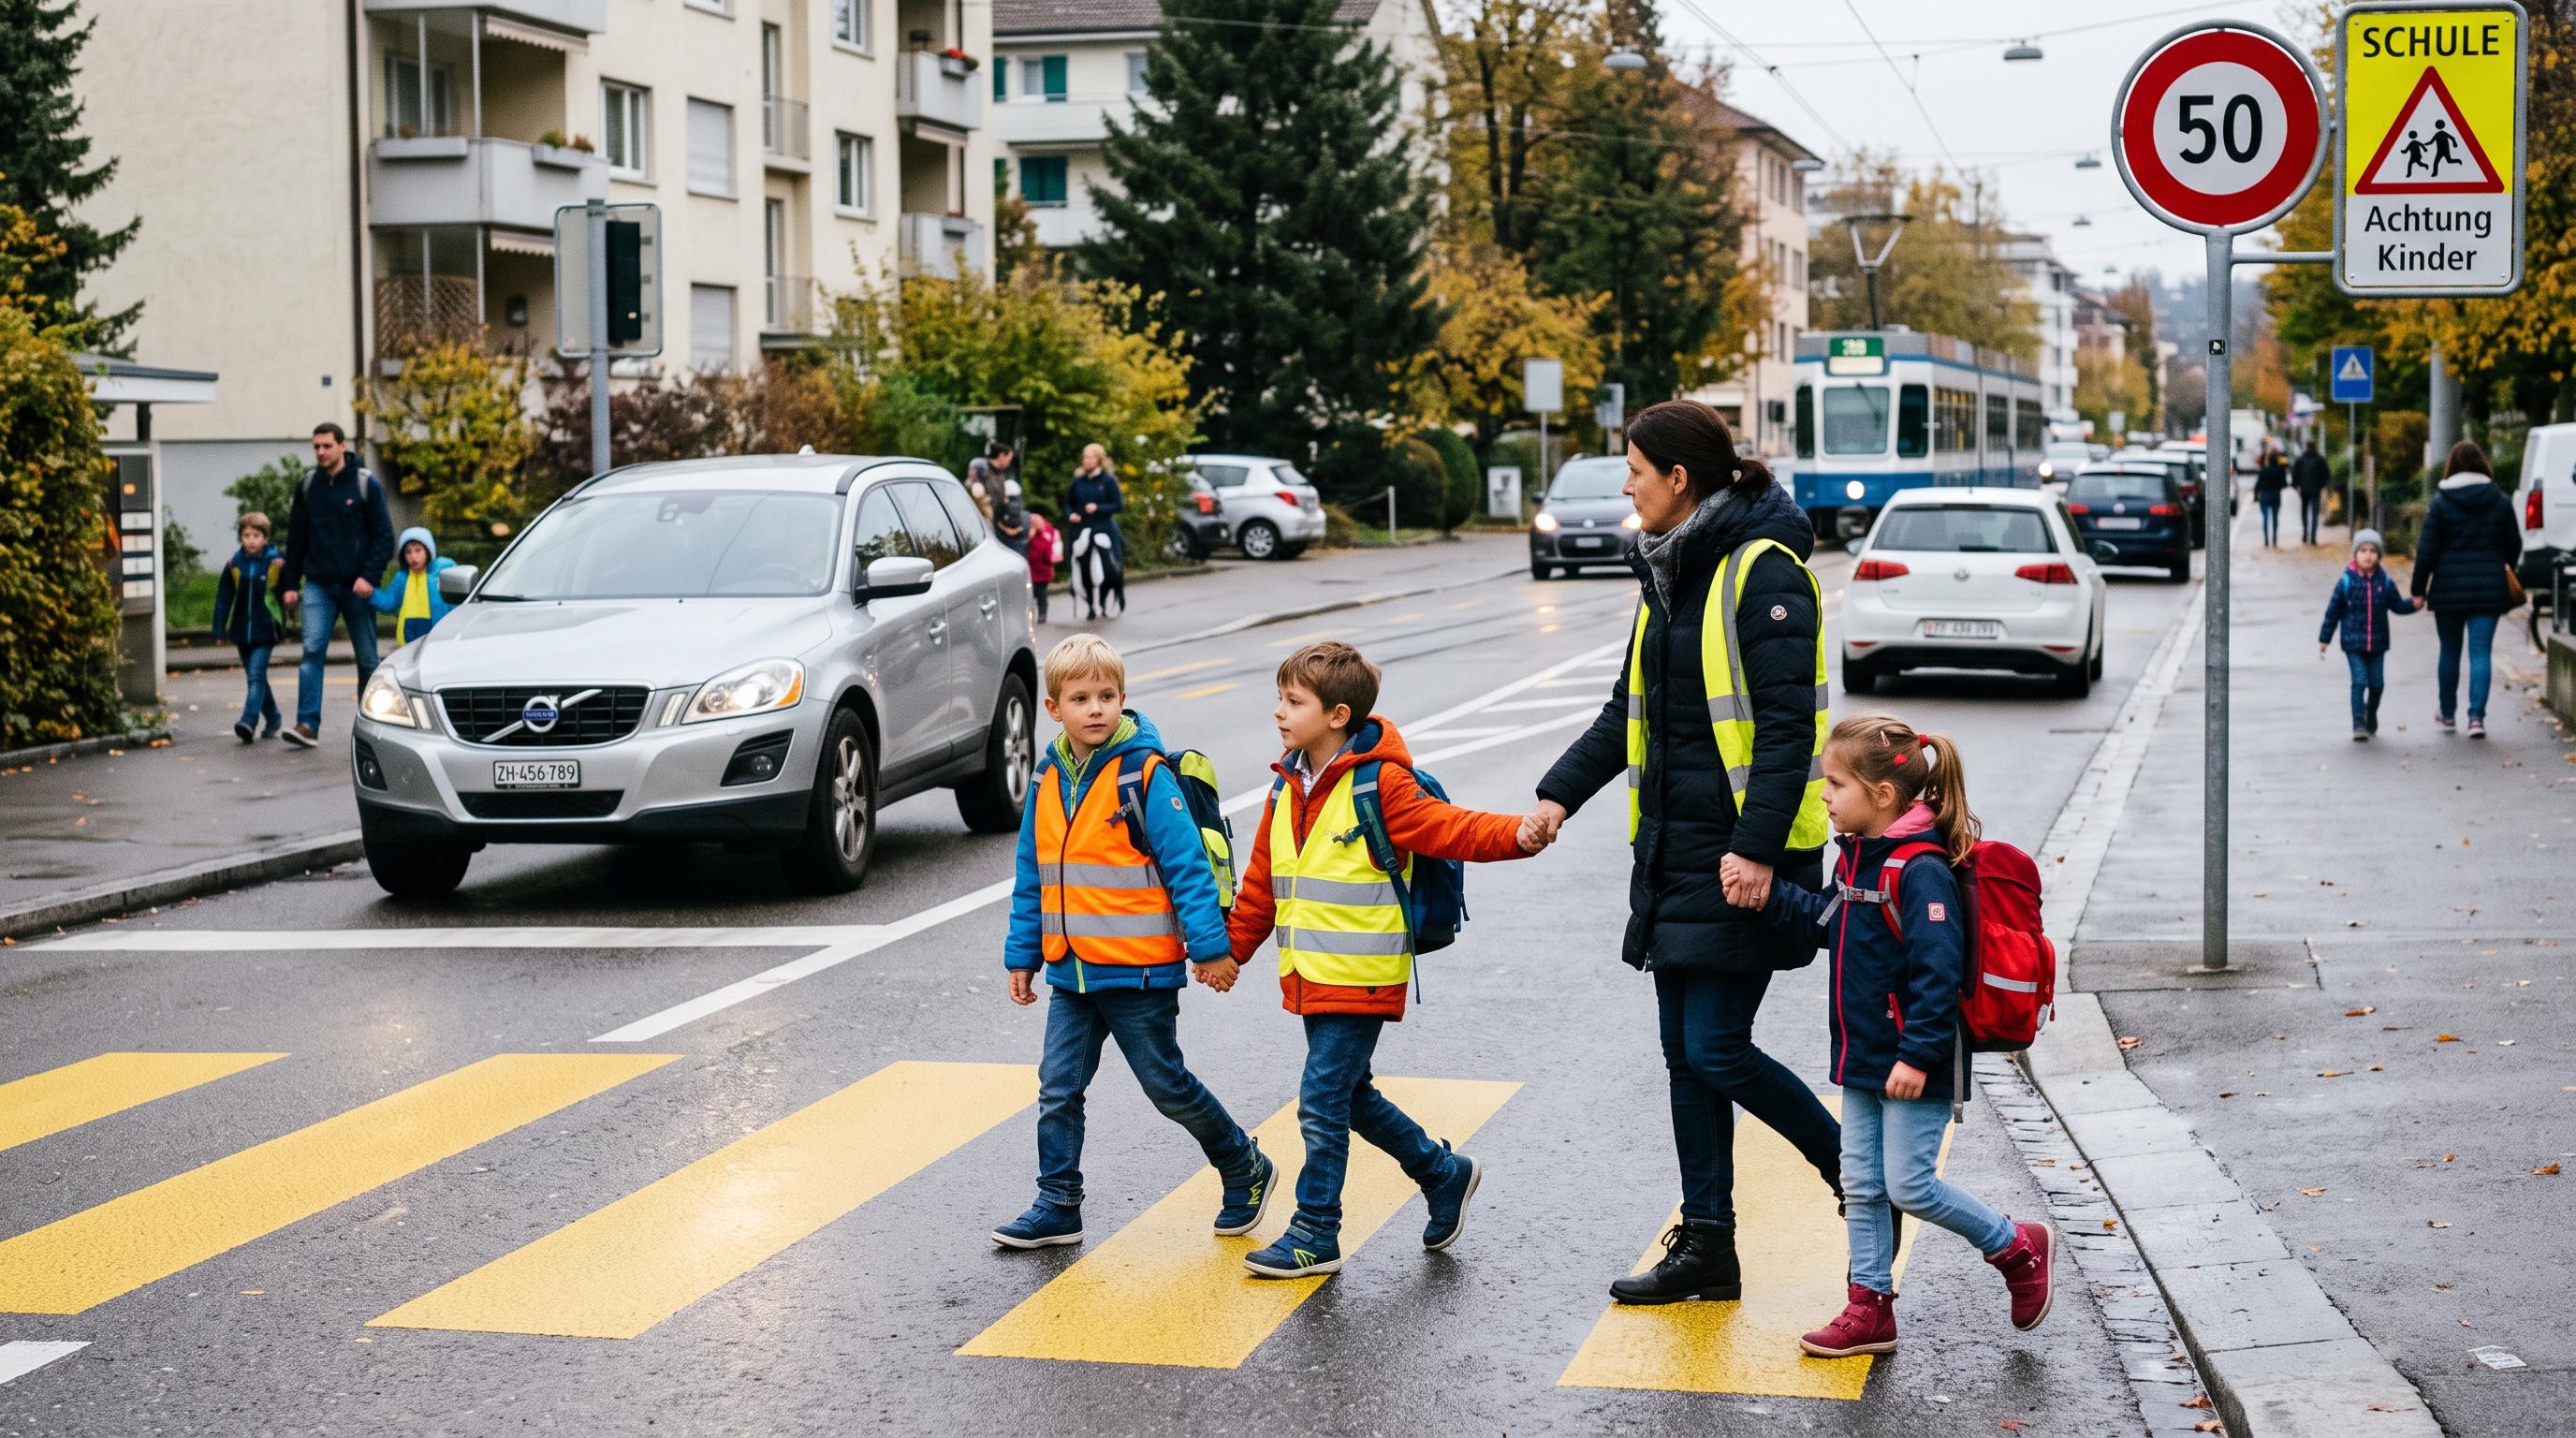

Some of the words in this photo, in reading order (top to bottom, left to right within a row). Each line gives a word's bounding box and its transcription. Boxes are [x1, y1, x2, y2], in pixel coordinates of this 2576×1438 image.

[2363, 24, 2499, 57] SCHULE
[2178, 93, 2263, 165] 50
[2364, 203, 2493, 239] Achtung
[2378, 242, 2478, 271] Kinder
